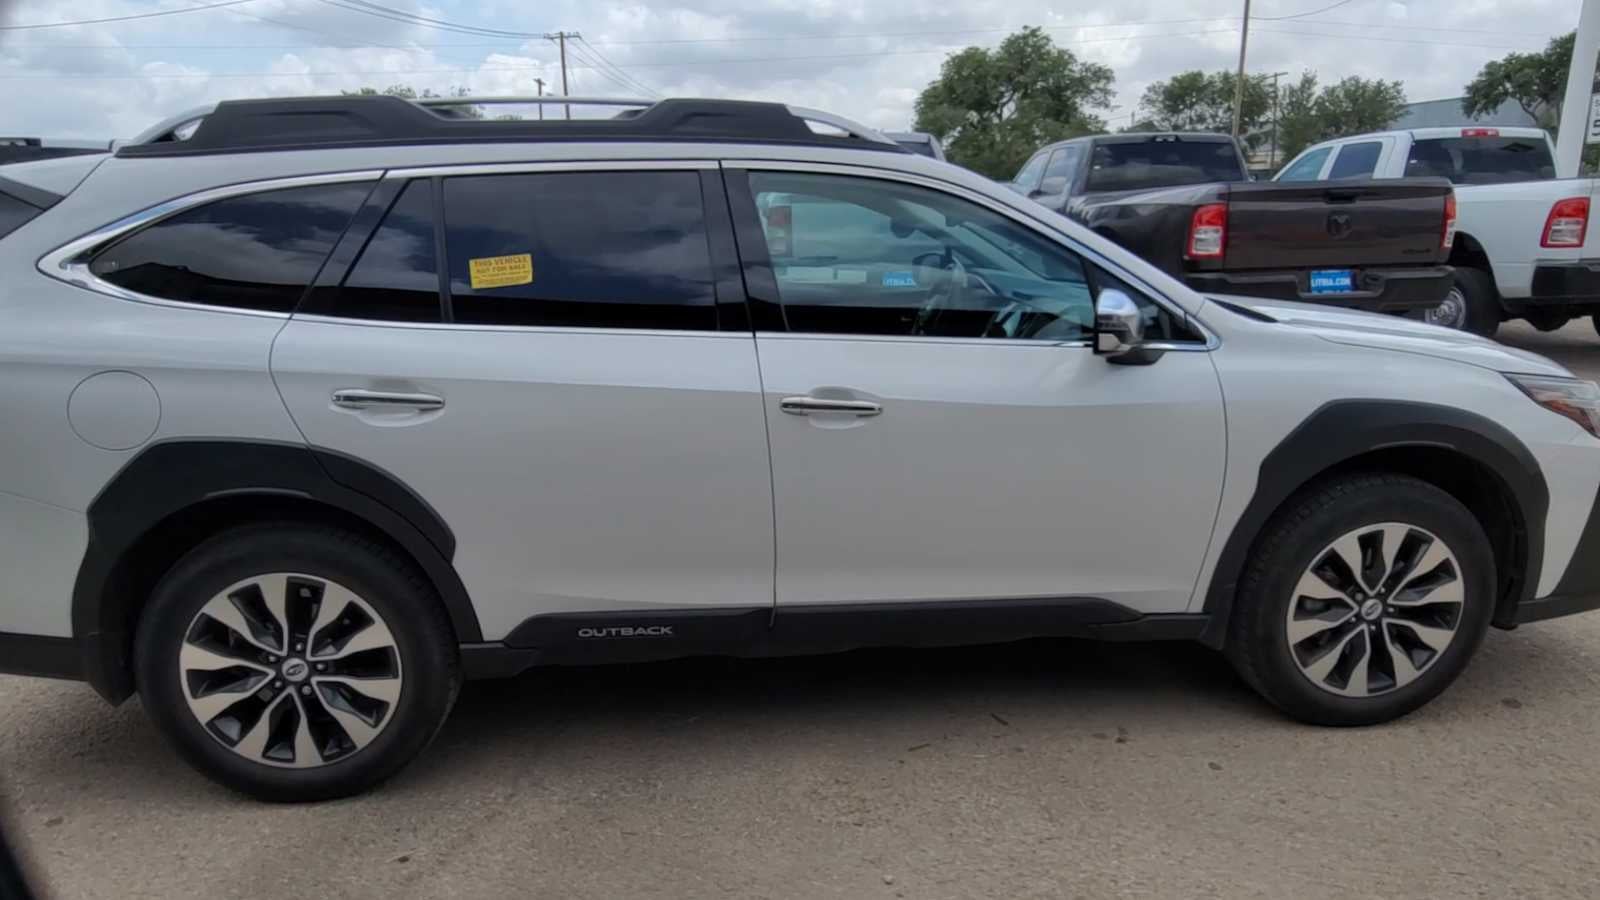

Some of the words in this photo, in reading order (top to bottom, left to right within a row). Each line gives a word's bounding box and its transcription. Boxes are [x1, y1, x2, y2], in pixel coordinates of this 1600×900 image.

[495, 255, 529, 265] VEHICLE
[492, 264, 508, 273] FOR
[578, 626, 673, 637] OUTBACK
